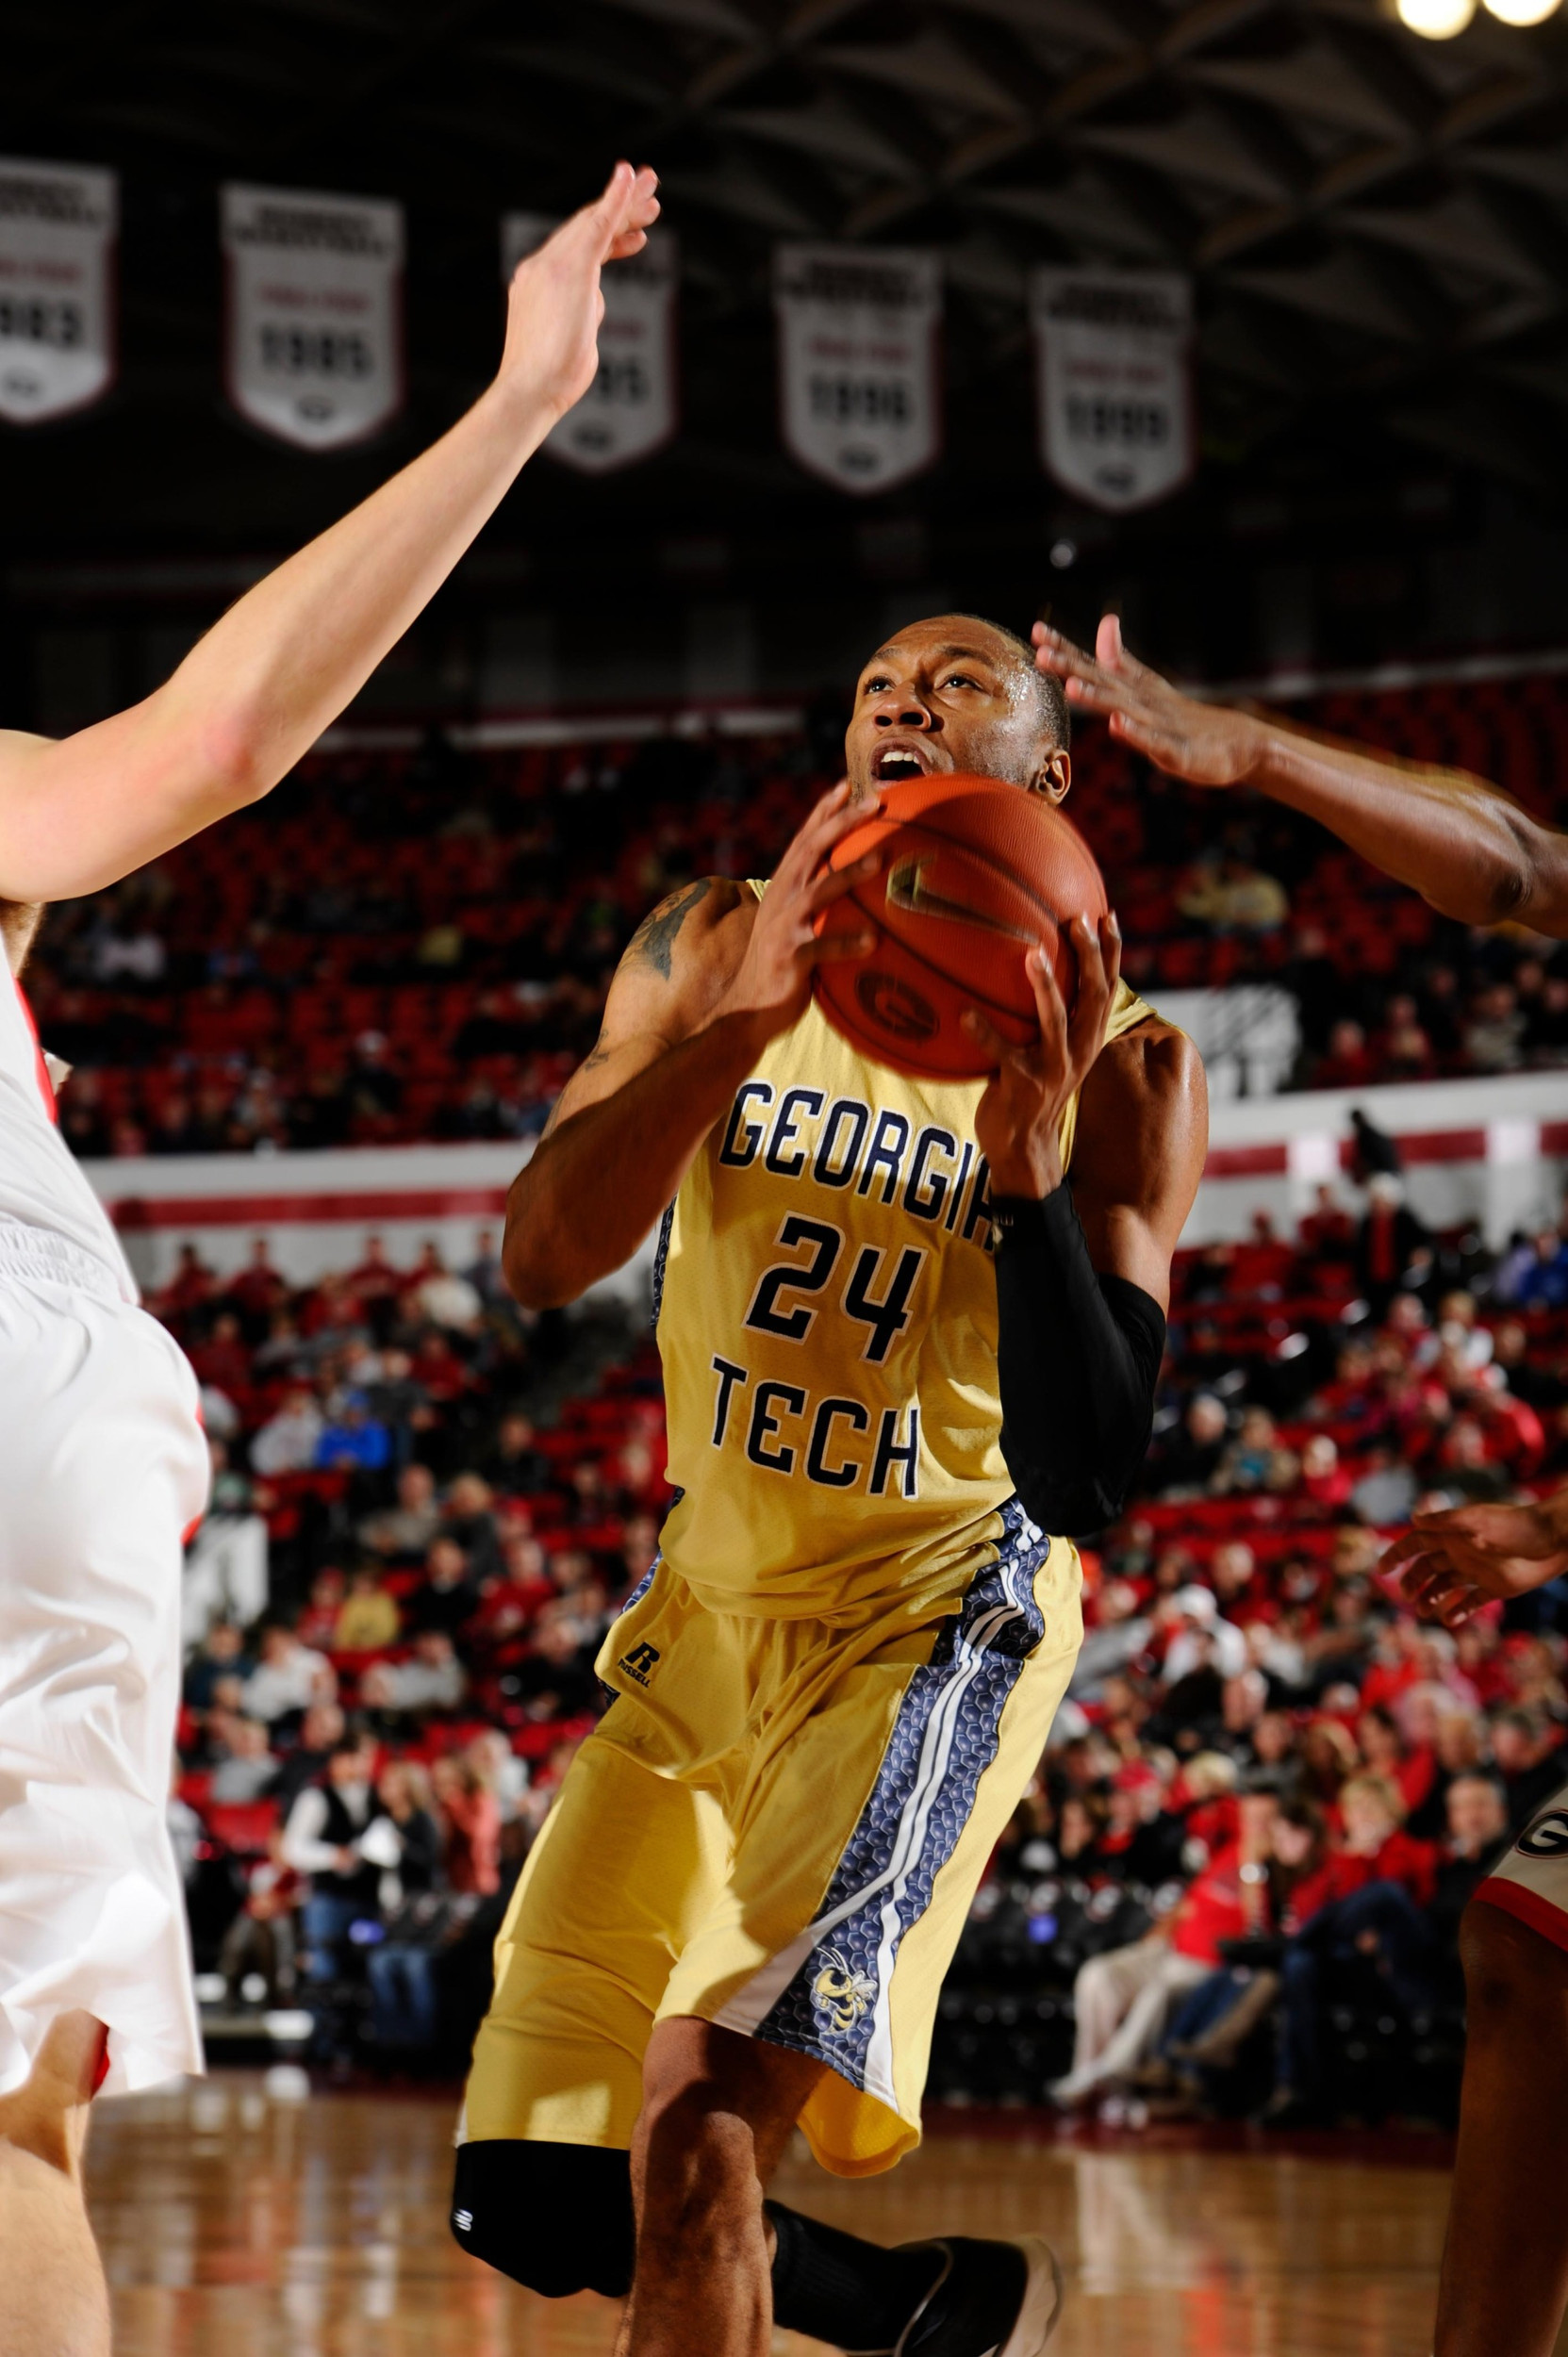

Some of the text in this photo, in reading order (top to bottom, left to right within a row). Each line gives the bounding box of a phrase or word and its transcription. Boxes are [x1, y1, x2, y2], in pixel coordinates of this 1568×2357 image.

[0, 301, 81, 350] 983
[741, 1211, 928, 1366] 24
[711, 1352, 920, 1498] TECH
[625, 1642, 660, 1673] R
